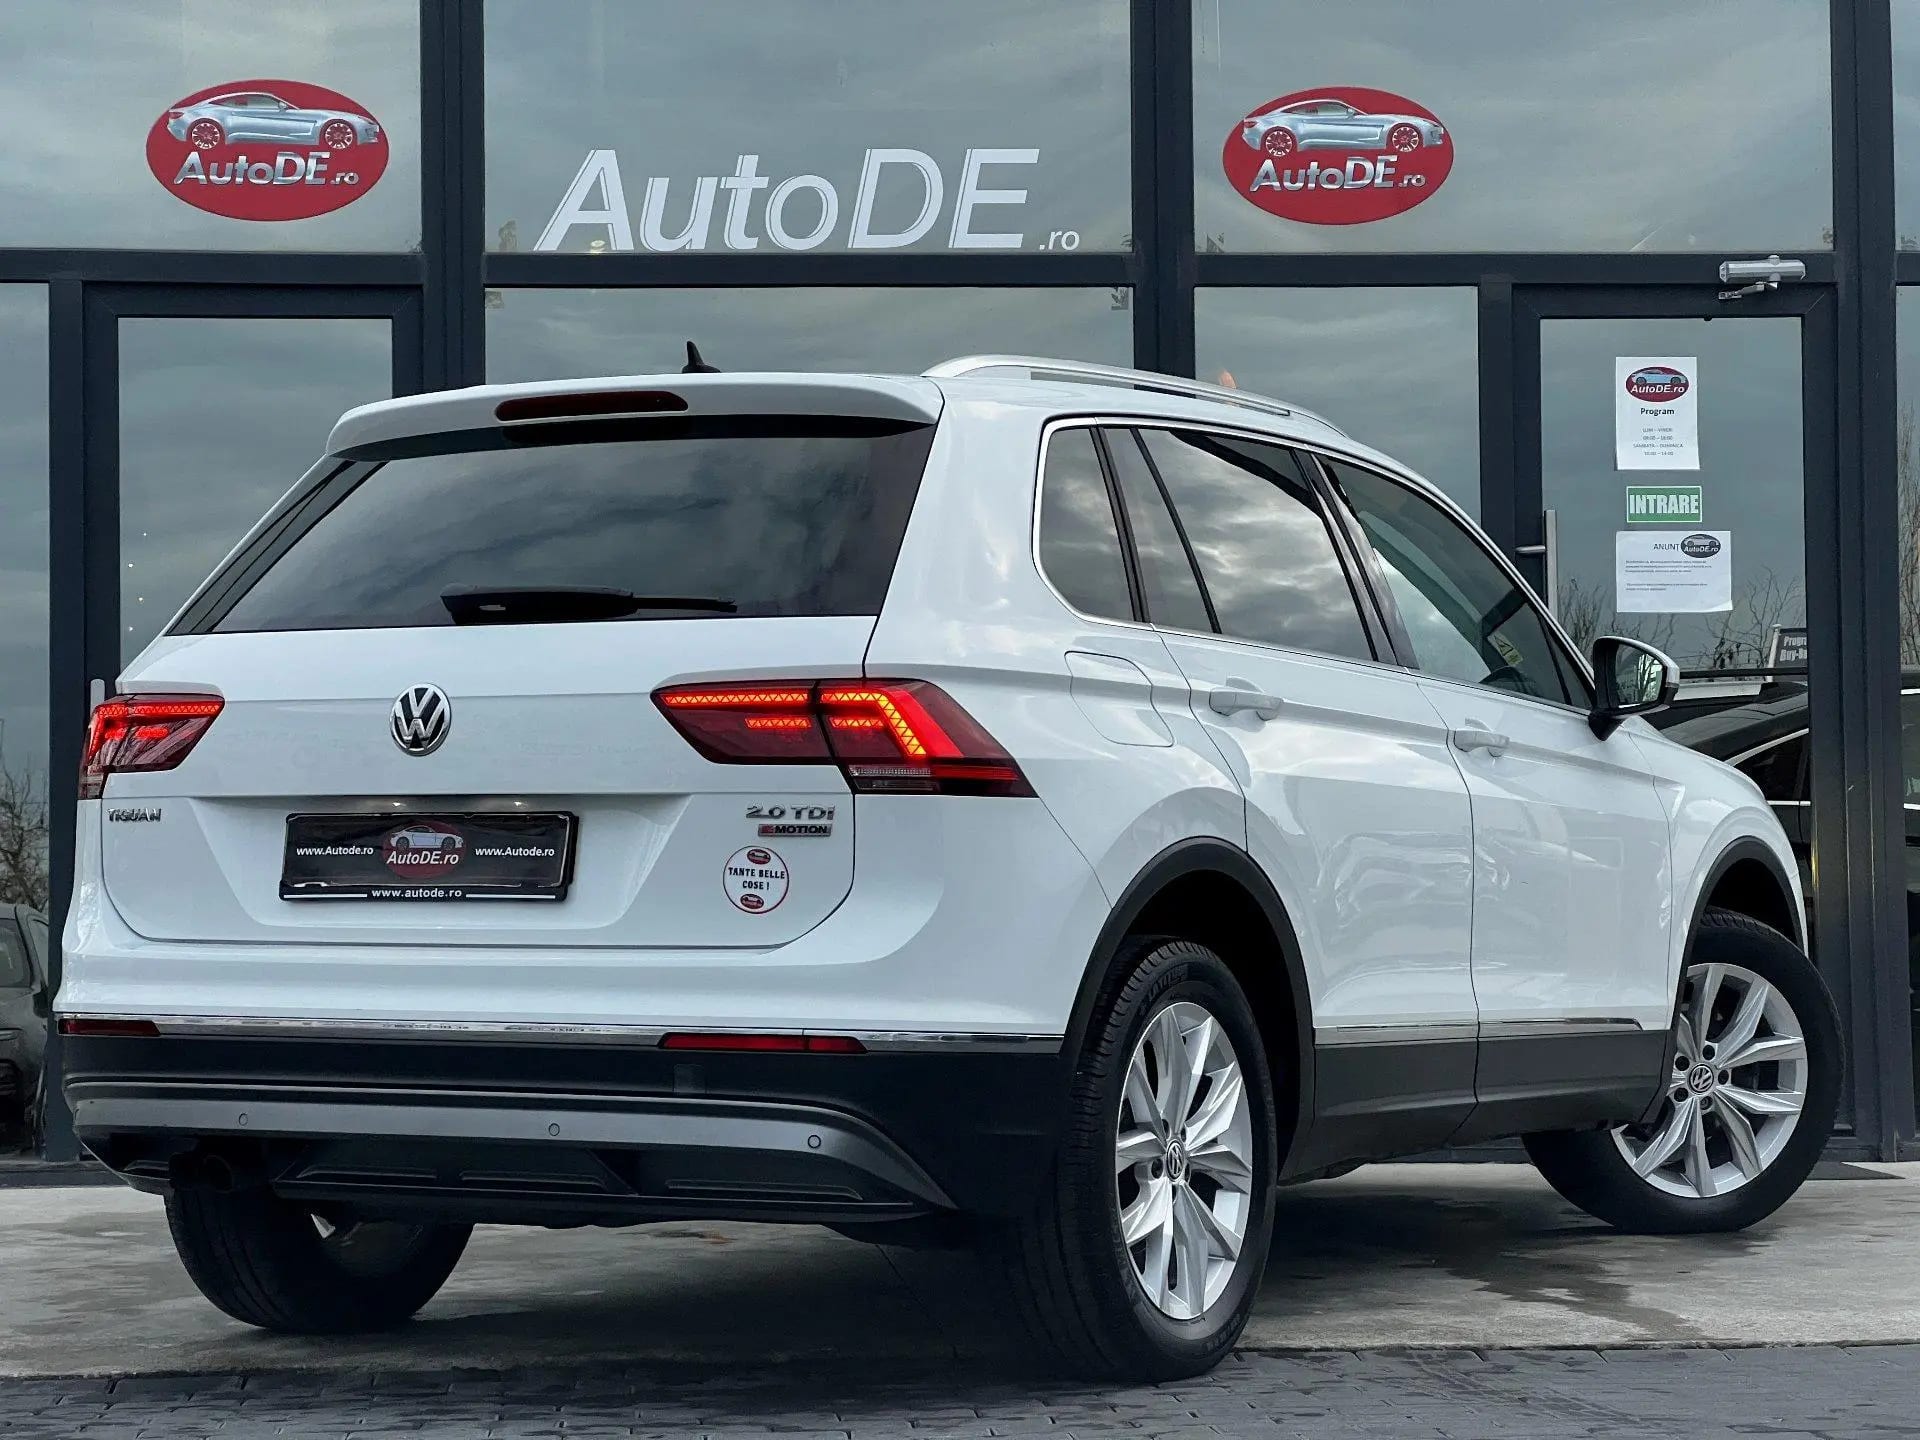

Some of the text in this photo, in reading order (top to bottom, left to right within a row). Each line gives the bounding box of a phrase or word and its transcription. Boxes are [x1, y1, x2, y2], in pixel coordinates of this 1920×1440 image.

[1630, 384, 1685, 393] AutoDE.ro
[1640, 407, 1675, 416] Program
[1629, 494, 1699, 514] INTRARE
[107, 807, 162, 822] TIGUAN
[746, 805, 785, 819] 2.0
[296, 845, 555, 866] www.Autode.ro AutoDE.ro www.Autode.ro
[728, 867, 785, 879] TANTE BELLE
[742, 880, 764, 890] COSE
[371, 887, 463, 898] www.autode.ro
